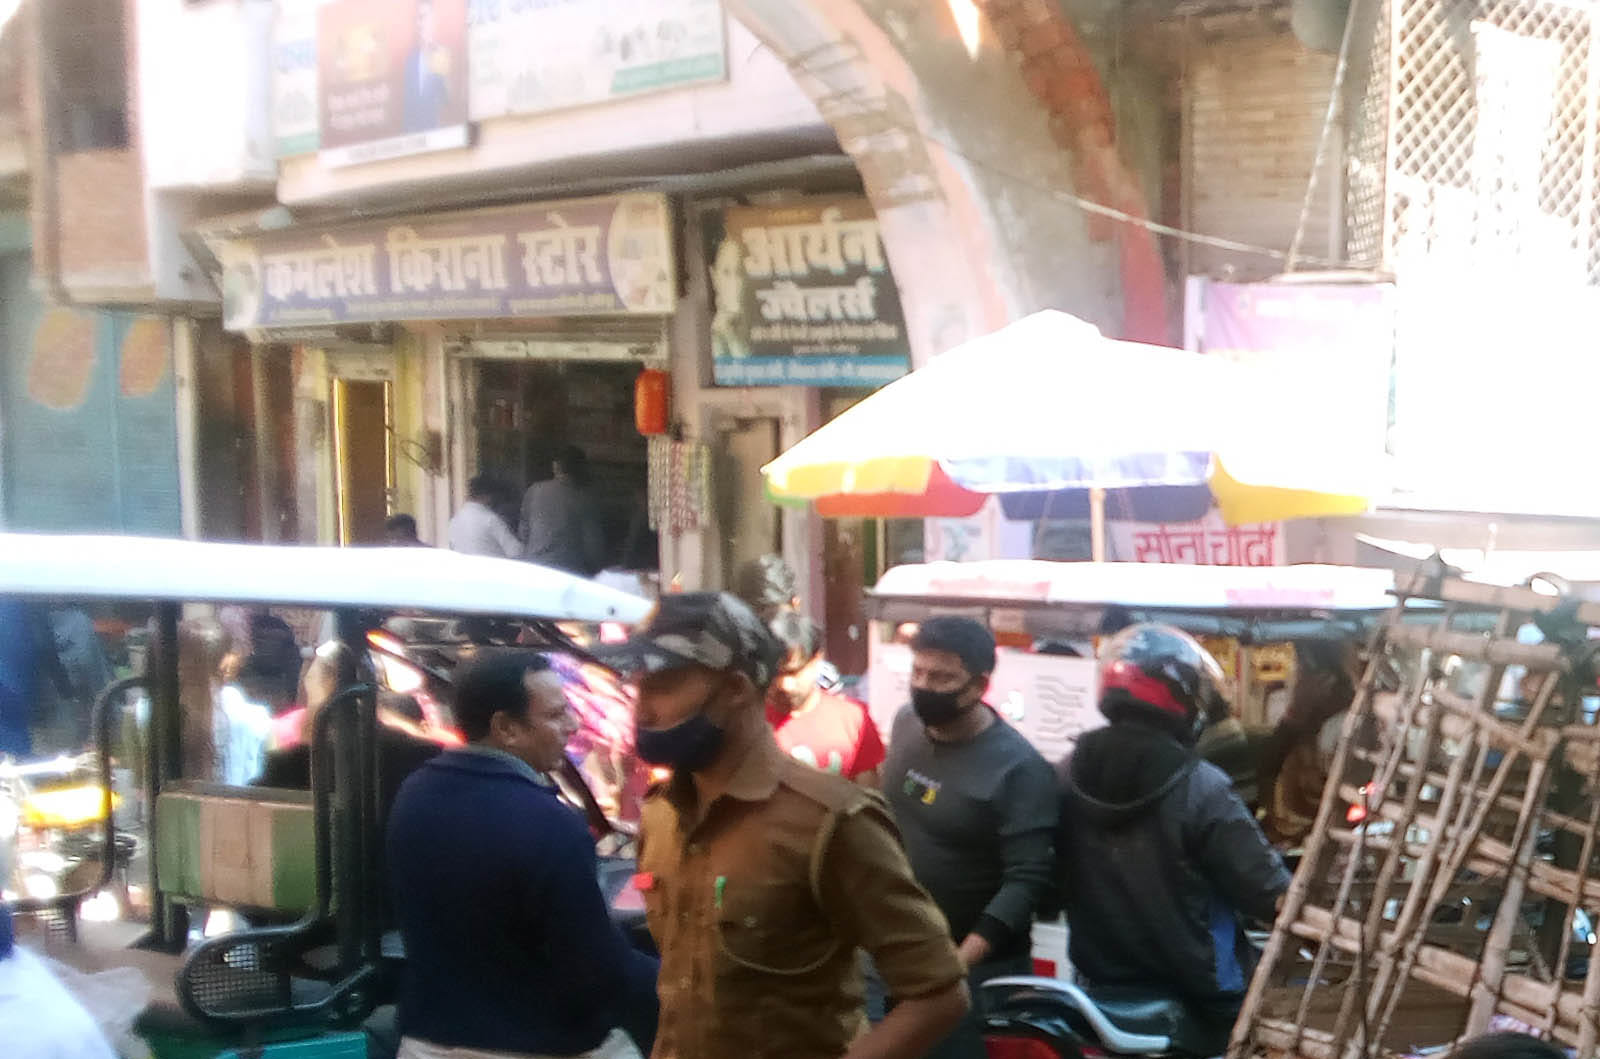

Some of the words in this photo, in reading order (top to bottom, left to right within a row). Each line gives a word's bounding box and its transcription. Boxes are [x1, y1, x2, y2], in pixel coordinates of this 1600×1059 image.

[386, 224, 507, 294] किराना
[517, 211, 602, 288] स्टोर
[742, 207, 885, 275] आर्यन
